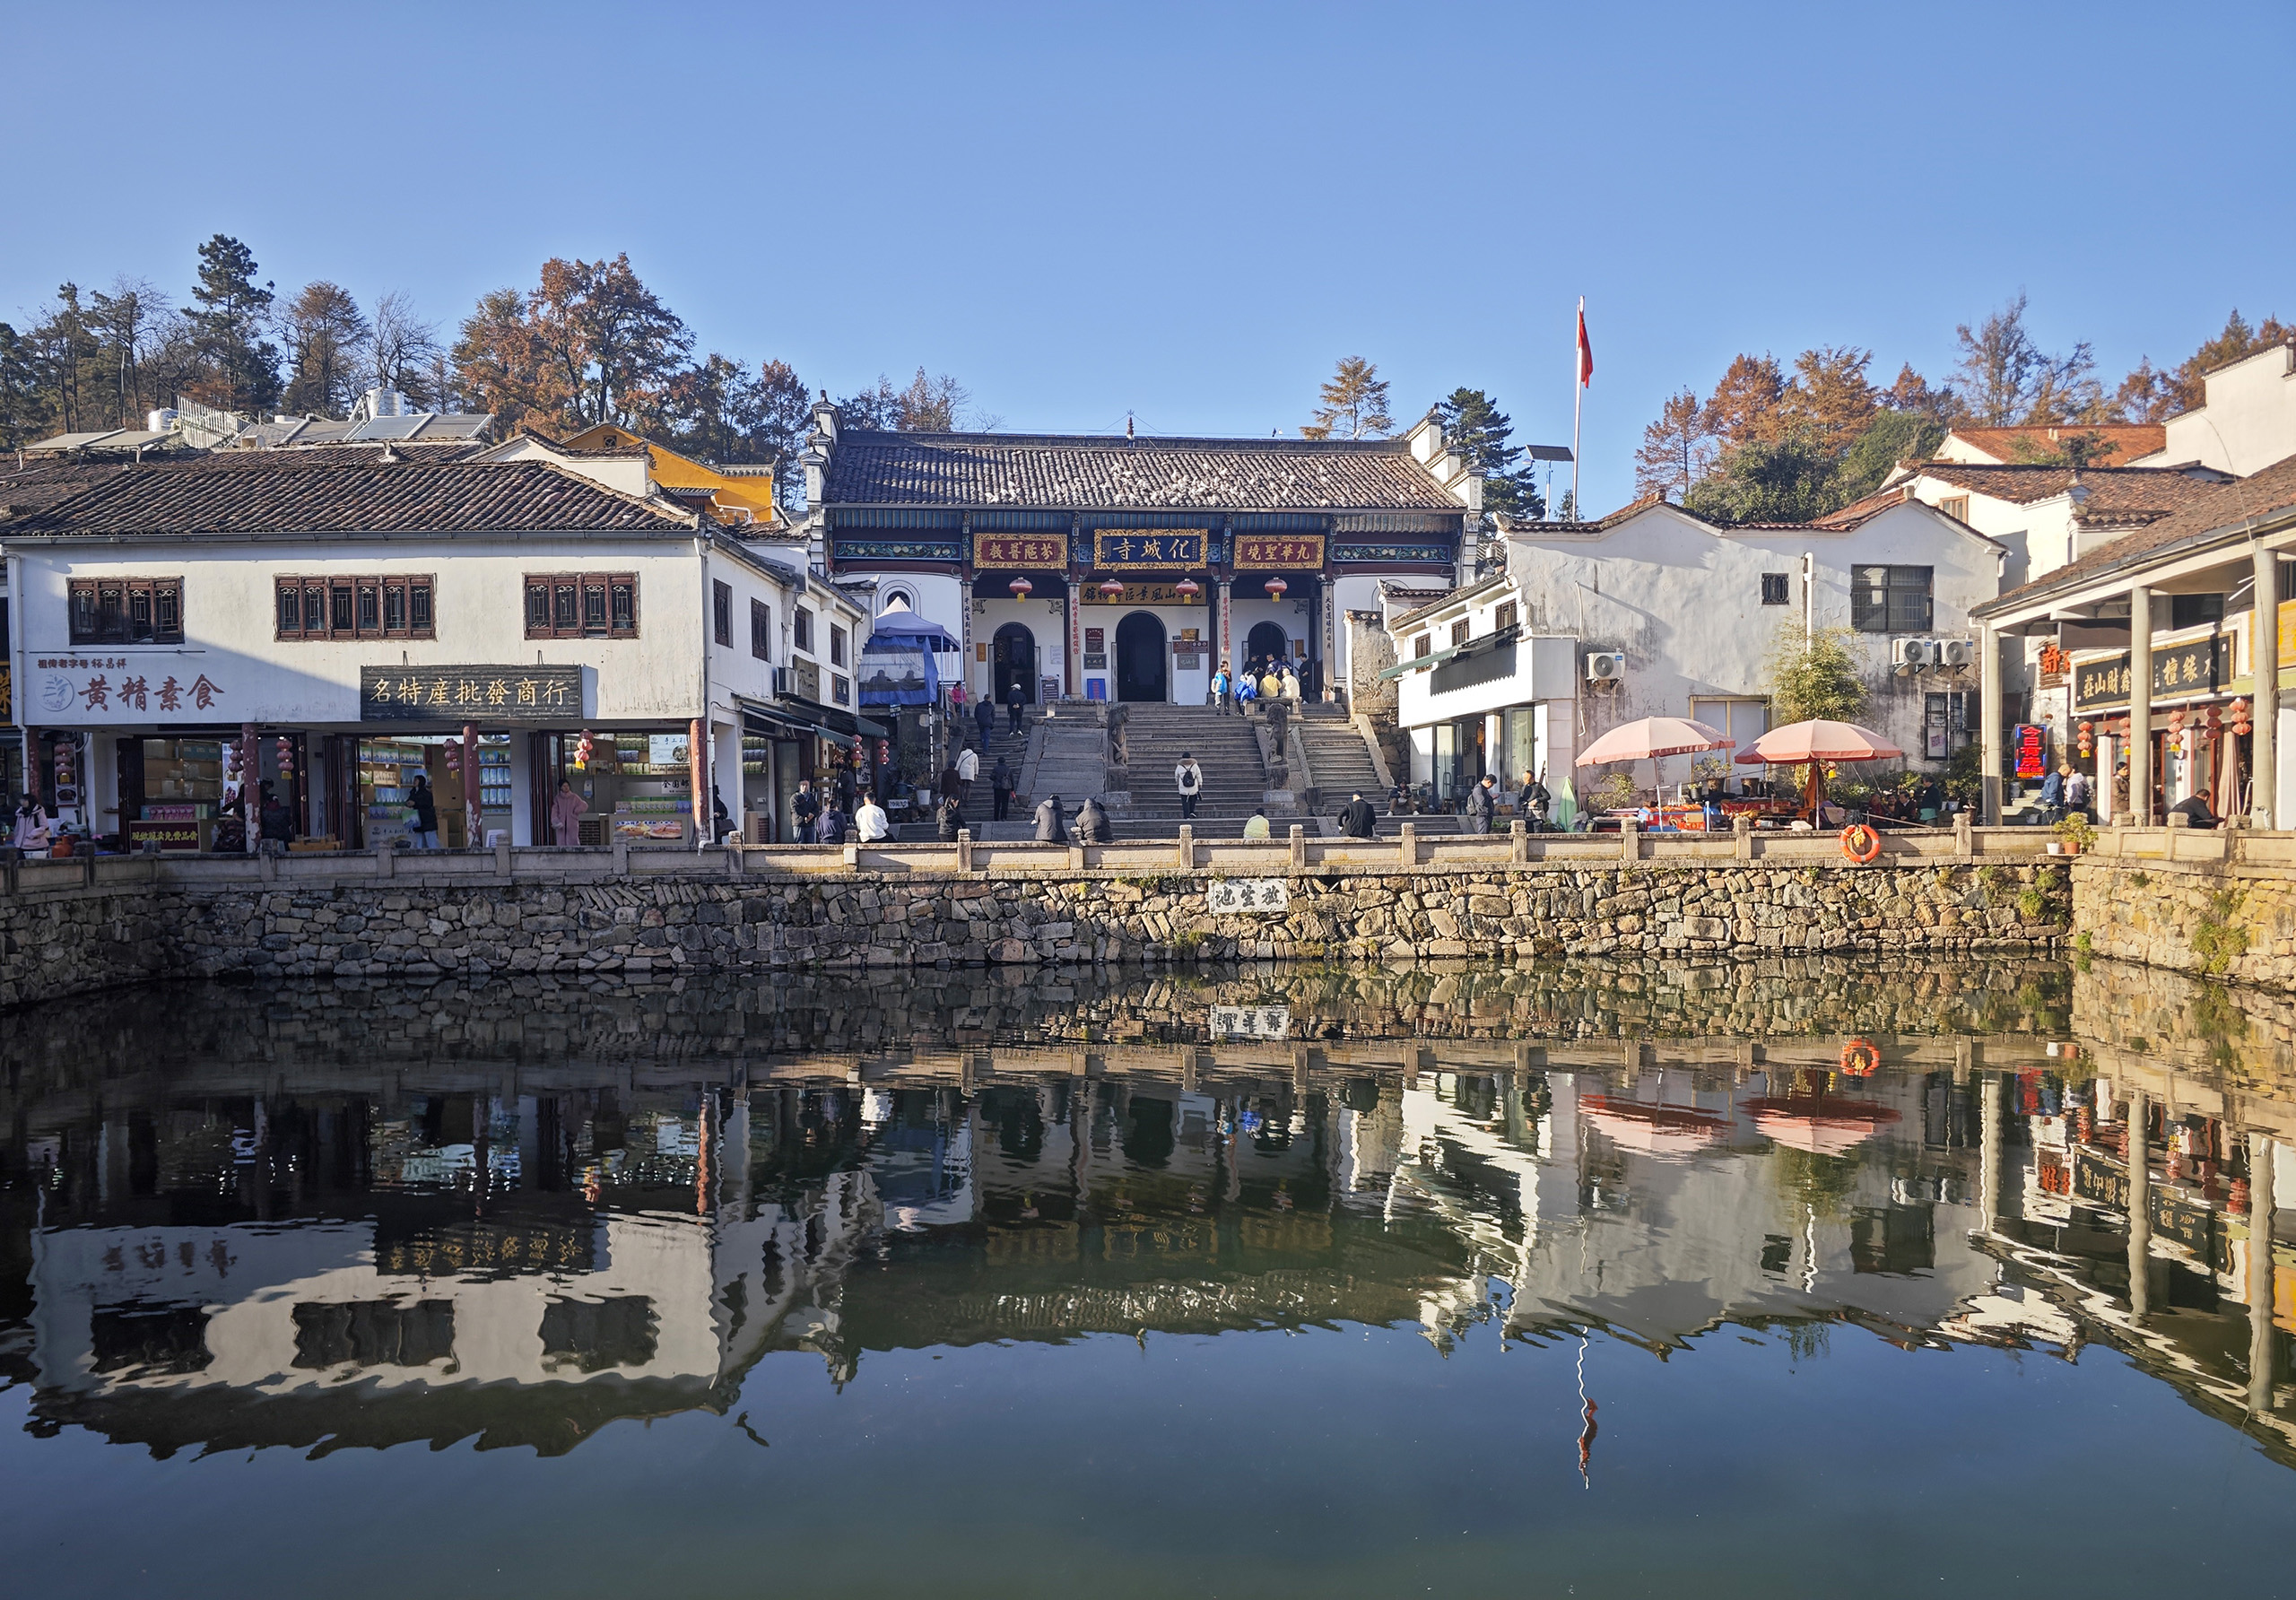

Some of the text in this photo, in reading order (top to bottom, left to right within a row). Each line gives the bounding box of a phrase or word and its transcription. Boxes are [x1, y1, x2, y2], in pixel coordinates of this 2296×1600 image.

[1112, 538, 1189, 561] 化城寺
[78, 674, 224, 712] 黄精素食
[1215, 884, 1283, 908] 放生池
